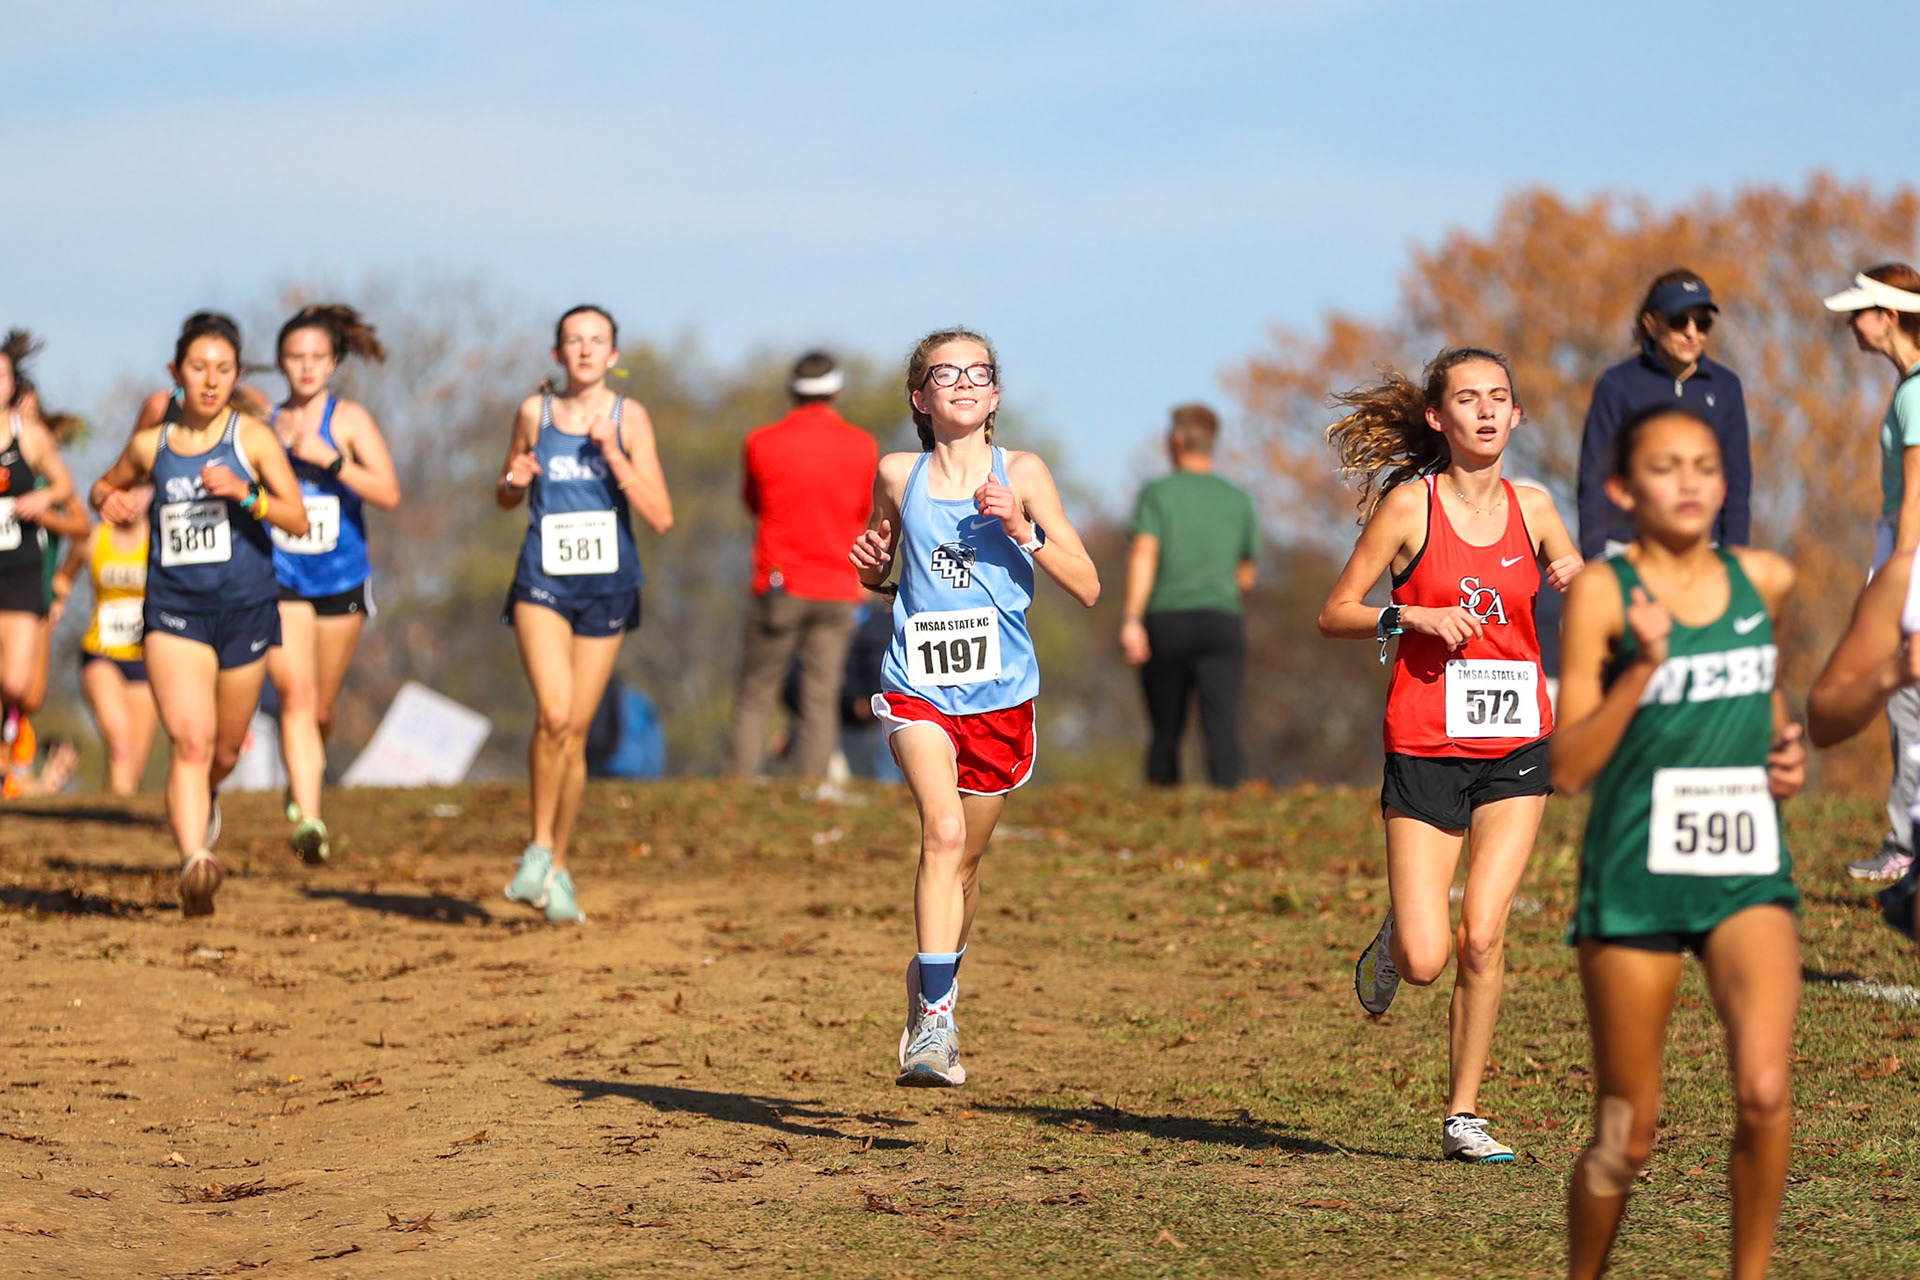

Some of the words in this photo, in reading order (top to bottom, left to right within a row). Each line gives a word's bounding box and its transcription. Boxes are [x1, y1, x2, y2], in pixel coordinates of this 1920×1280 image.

[548, 454, 608, 482] SMS
[170, 525, 216, 554] 580
[558, 537, 602, 563] 581
[931, 549, 972, 589] SBA
[1459, 575, 1509, 626] SCA
[914, 620, 946, 632] TMSAA
[948, 618, 975, 631] STATE
[976, 616, 990, 628] XC
[917, 635, 988, 675] 1197
[1457, 669, 1491, 681] TMSAA
[1492, 669, 1516, 681] STATE
[1517, 670, 1529, 681] XC
[1466, 689, 1522, 725] 572
[1674, 810, 1757, 855] 590
